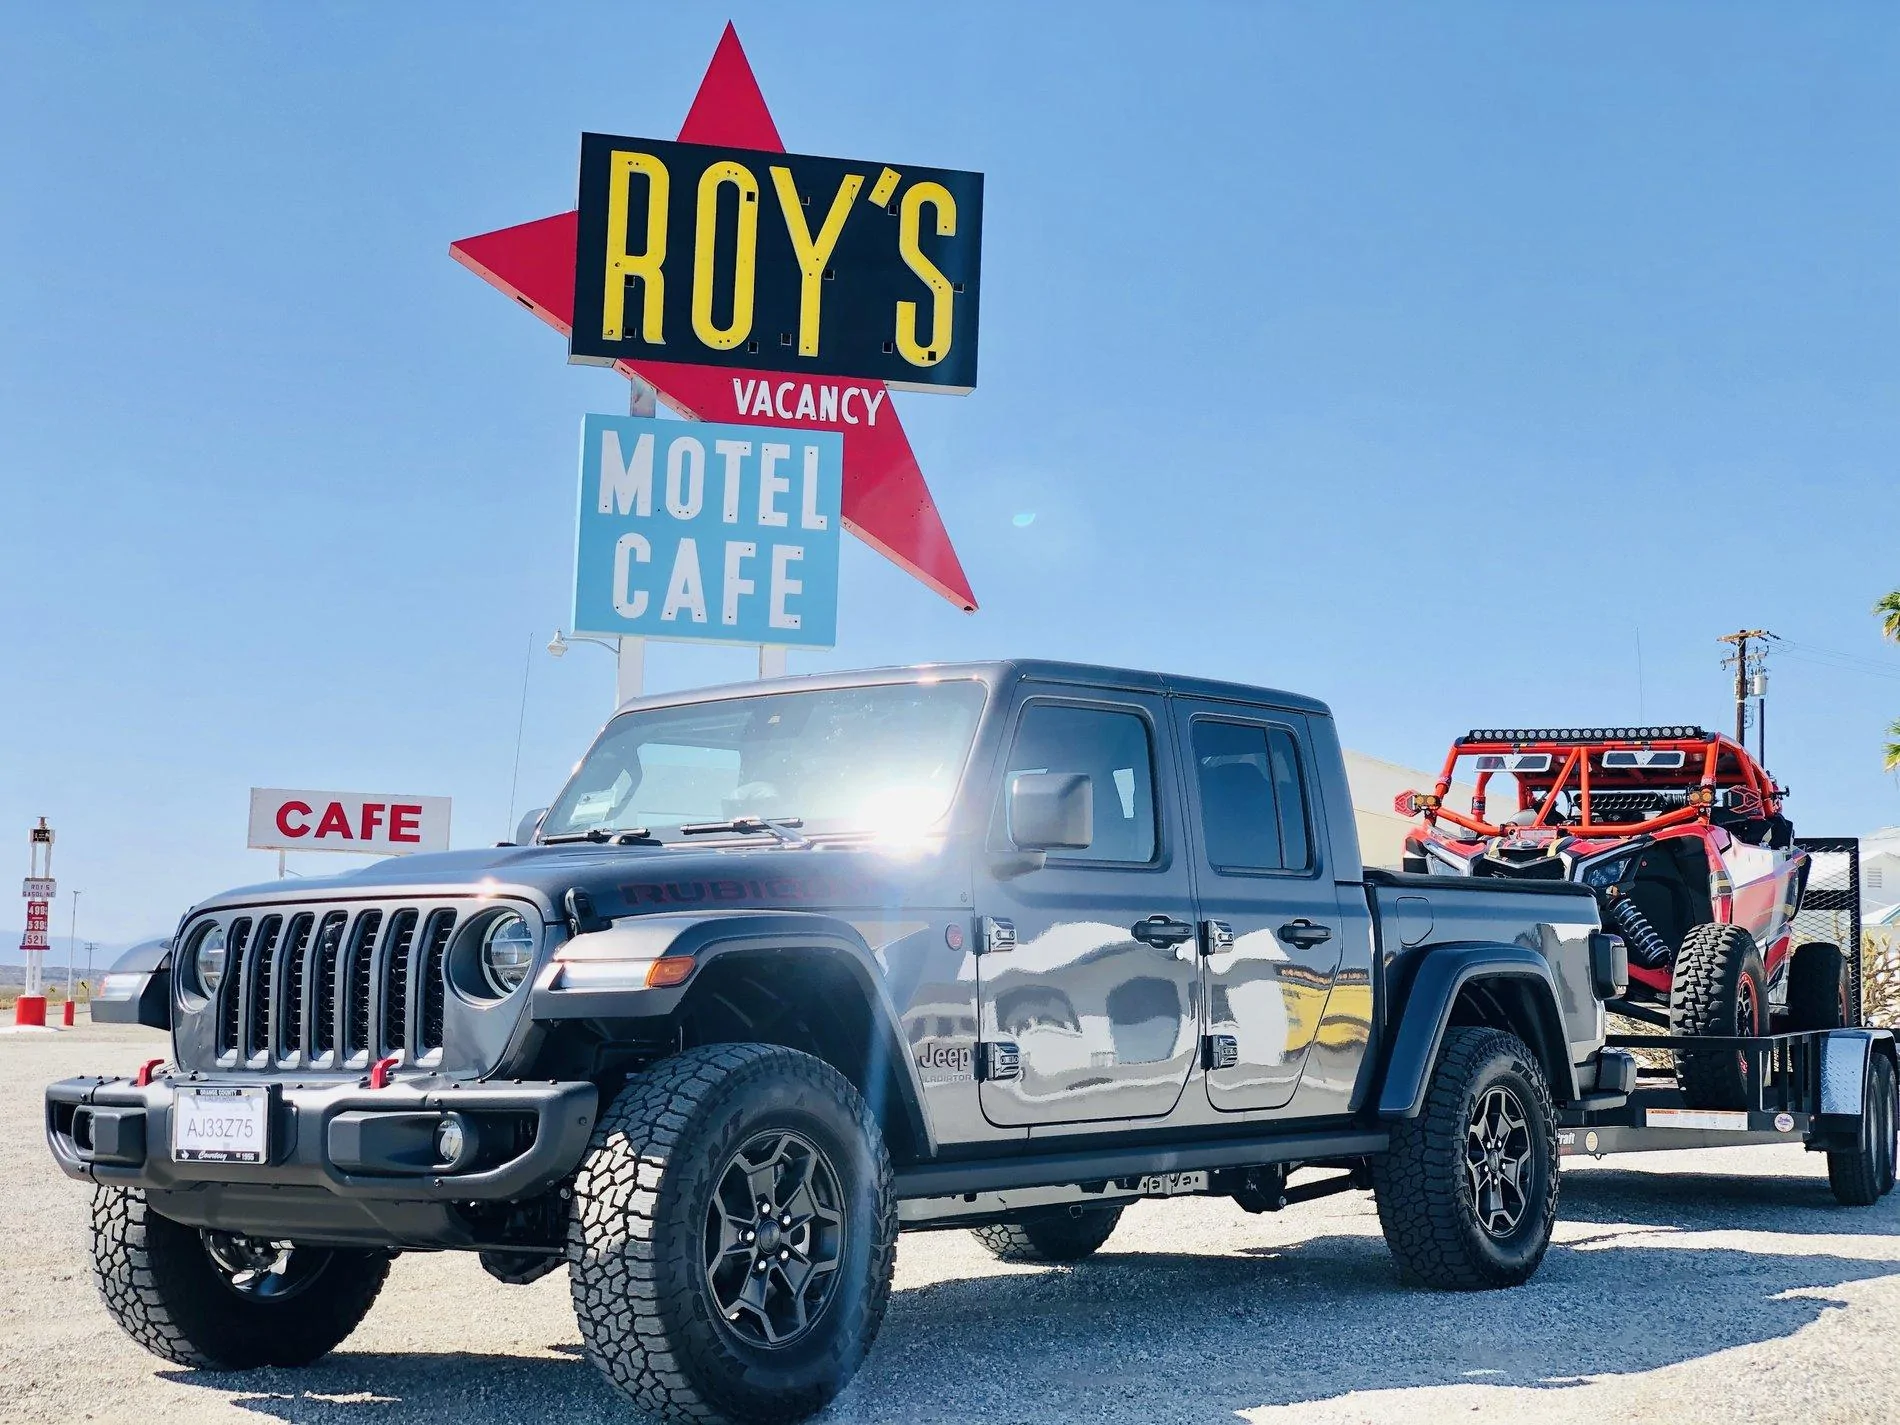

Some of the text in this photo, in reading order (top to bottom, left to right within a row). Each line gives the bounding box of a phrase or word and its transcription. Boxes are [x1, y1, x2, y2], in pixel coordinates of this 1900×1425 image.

[602, 149, 957, 368] ROY'S
[732, 378, 886, 427] VACANCY
[598, 430, 828, 531] MOTEL
[612, 532, 804, 630] CAFE
[276, 800, 423, 843] CAFE
[920, 1042, 972, 1071] Jeep
[187, 1118, 254, 1138] AJ33Z75
[1557, 1132, 1576, 1145] raft
